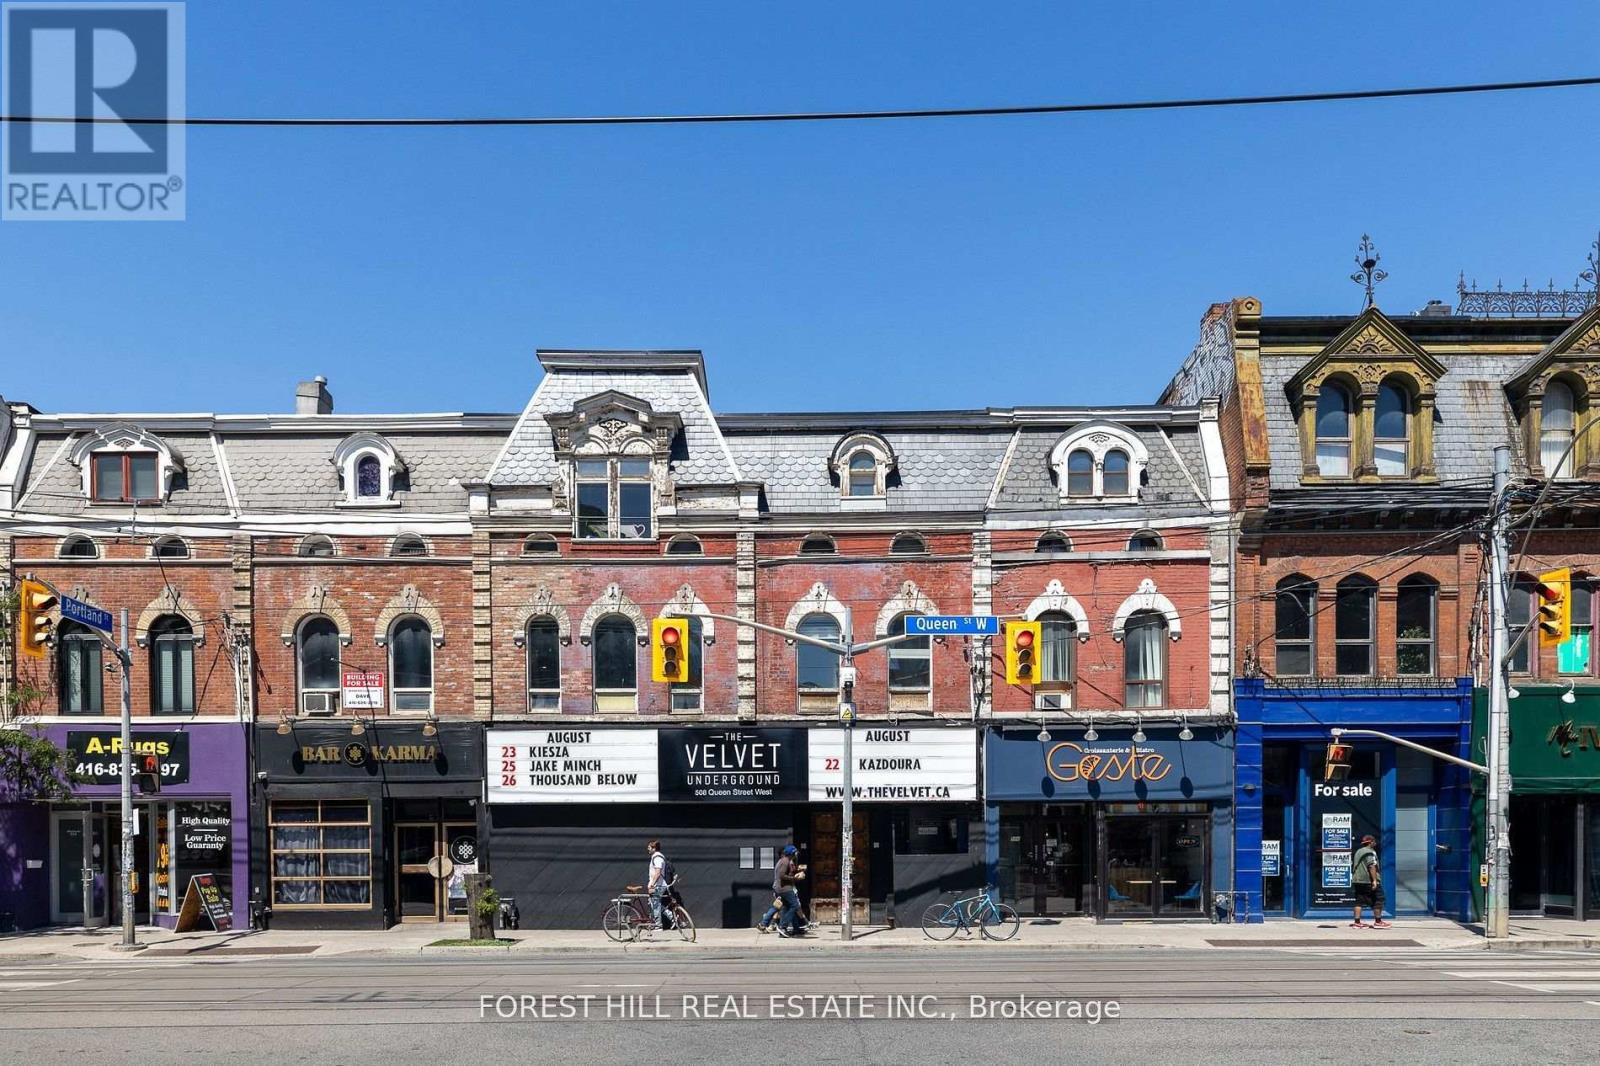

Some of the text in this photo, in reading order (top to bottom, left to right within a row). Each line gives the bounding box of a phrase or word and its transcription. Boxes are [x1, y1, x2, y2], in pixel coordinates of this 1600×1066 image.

[66, 598, 102, 625] Portland
[916, 617, 987, 631] Queen St W
[547, 731, 592, 744] AUGUST
[724, 732, 742, 741] THE
[865, 730, 911, 742] AUGUST
[302, 744, 437, 761] BAR KARMA
[501, 746, 570, 758] 23 KIESZA
[685, 743, 782, 769] VELVET
[75, 762, 180, 777] 416-85-97
[501, 760, 602, 772] 25 JAKE MINCH
[825, 758, 922, 770] 22 KAZDOURA
[502, 773, 638, 786] 26 THOUSAND BELOW
[687, 774, 780, 786] UNDERGROUND
[708, 788, 732, 797] Queen
[732, 788, 754, 796] Street
[755, 788, 773, 796] West
[1314, 783, 1373, 797] For sale
[181, 816, 231, 826] High Quality
[184, 833, 227, 842] Low Price
[186, 841, 224, 851] Guaranty
